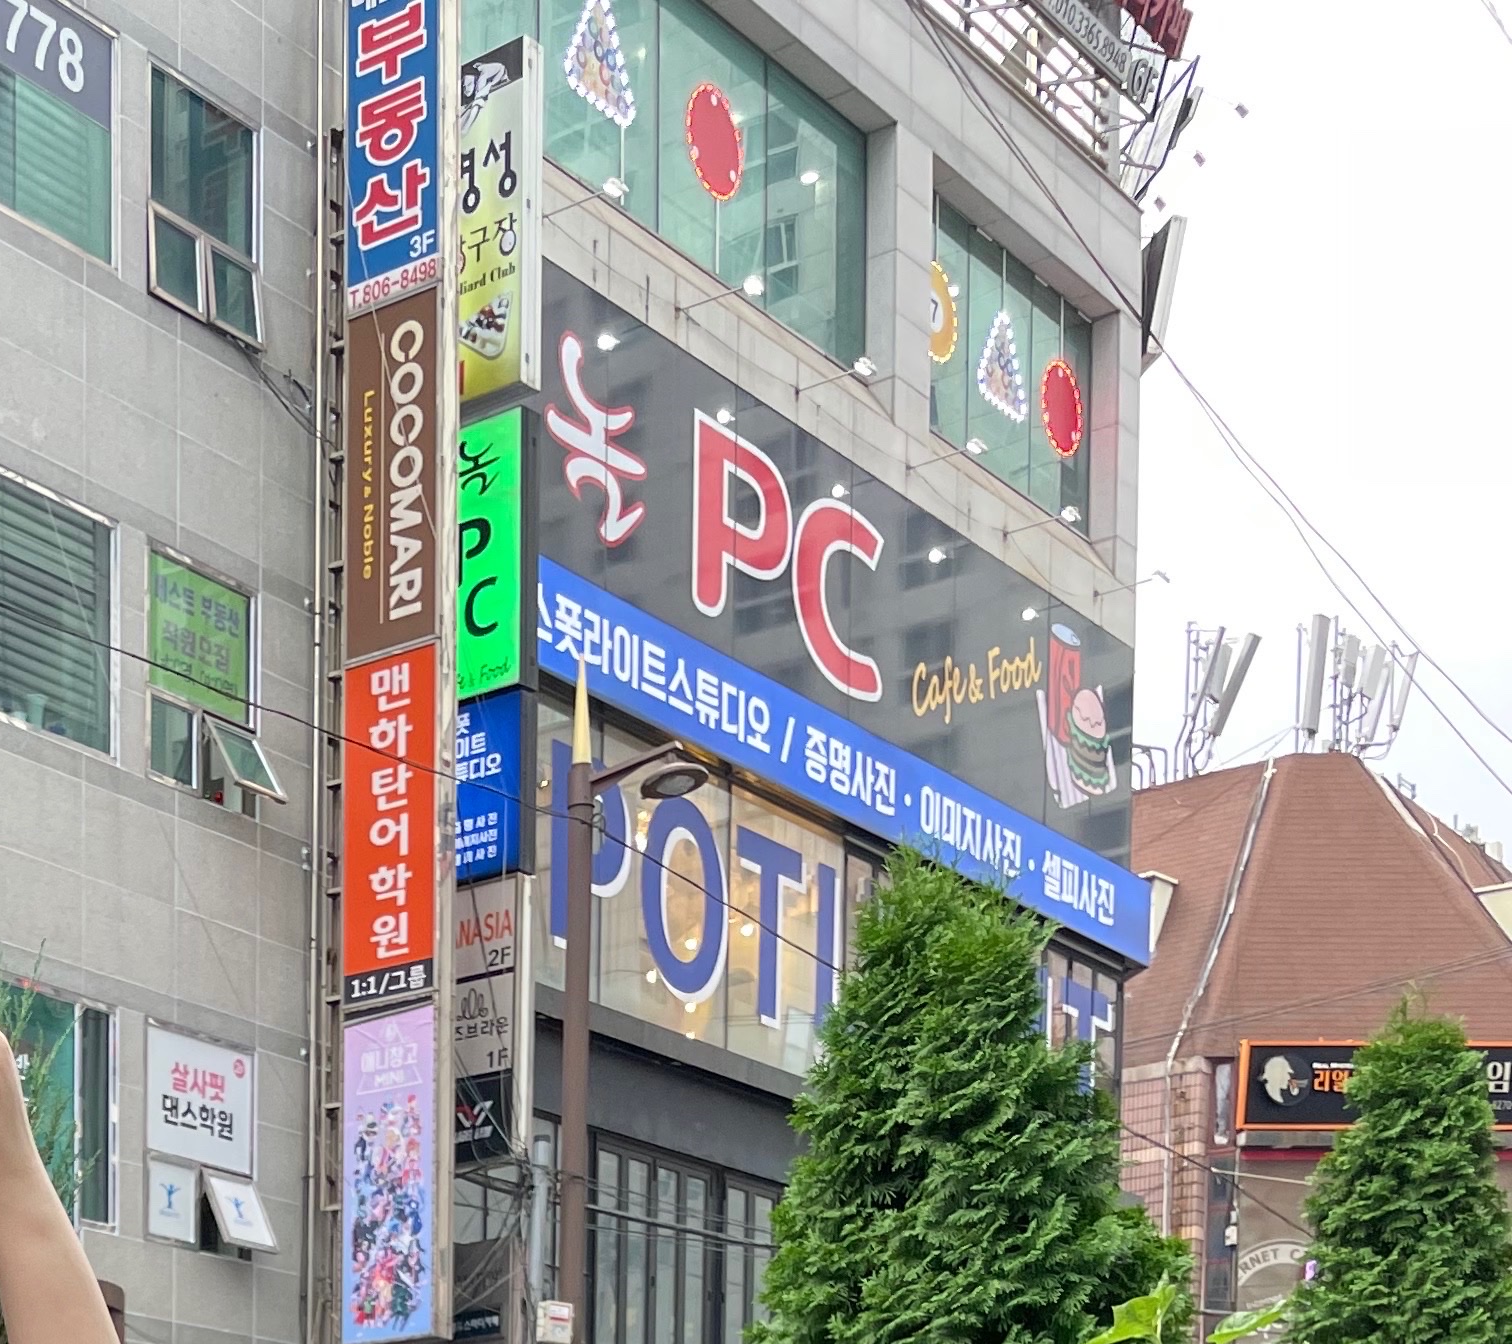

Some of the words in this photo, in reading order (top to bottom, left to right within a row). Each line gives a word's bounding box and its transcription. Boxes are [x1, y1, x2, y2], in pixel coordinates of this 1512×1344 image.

[354, 1, 429, 250] 부동산
[409, 229, 435, 258] 3F
[349, 257, 437, 311] T.806-8498
[389, 319, 424, 621] COCOMARI
[692, 408, 885, 703] PC
[911, 655, 967, 725] Cafe
[987, 636, 1042, 699] Food
[368, 662, 414, 960] 맨하탄어학원
[804, 725, 896, 817] 증명사진
[919, 785, 1022, 878] 이미지사진
[1042, 850, 1115, 926] 셀피사진
[488, 946, 512, 967] 2F
[171, 1061, 225, 1103] 살사핏
[487, 1047, 508, 1069] 1F
[162, 1094, 234, 1142] 댄스학원
